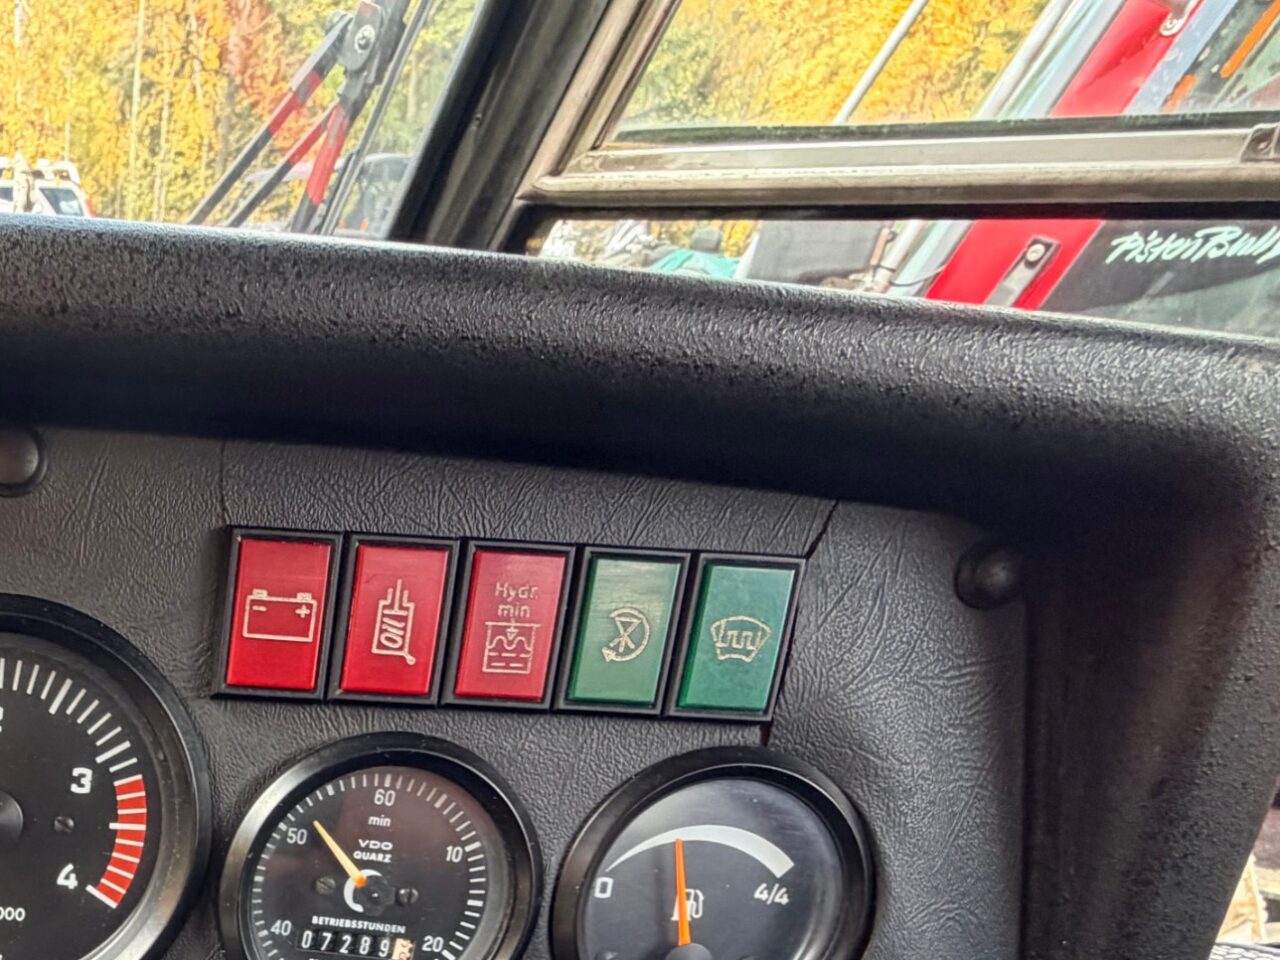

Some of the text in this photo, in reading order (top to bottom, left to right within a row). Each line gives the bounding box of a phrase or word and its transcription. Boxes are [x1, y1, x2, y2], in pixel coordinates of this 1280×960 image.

[498, 602, 530, 618] min
[71, 767, 93, 794] 3
[373, 788, 396, 807] 60
[368, 813, 391, 827] min
[286, 828, 307, 846] 50
[358, 838, 393, 850] VDO
[353, 850, 392, 864] QUARZ
[445, 845, 463, 864] 10
[57, 863, 78, 890] 4
[594, 877, 614, 898] 0
[753, 883, 790, 905] 4/4
[270, 919, 292, 937] 40
[311, 915, 406, 934] BETRIEBSSTUNDEN
[422, 935, 444, 953] 20
